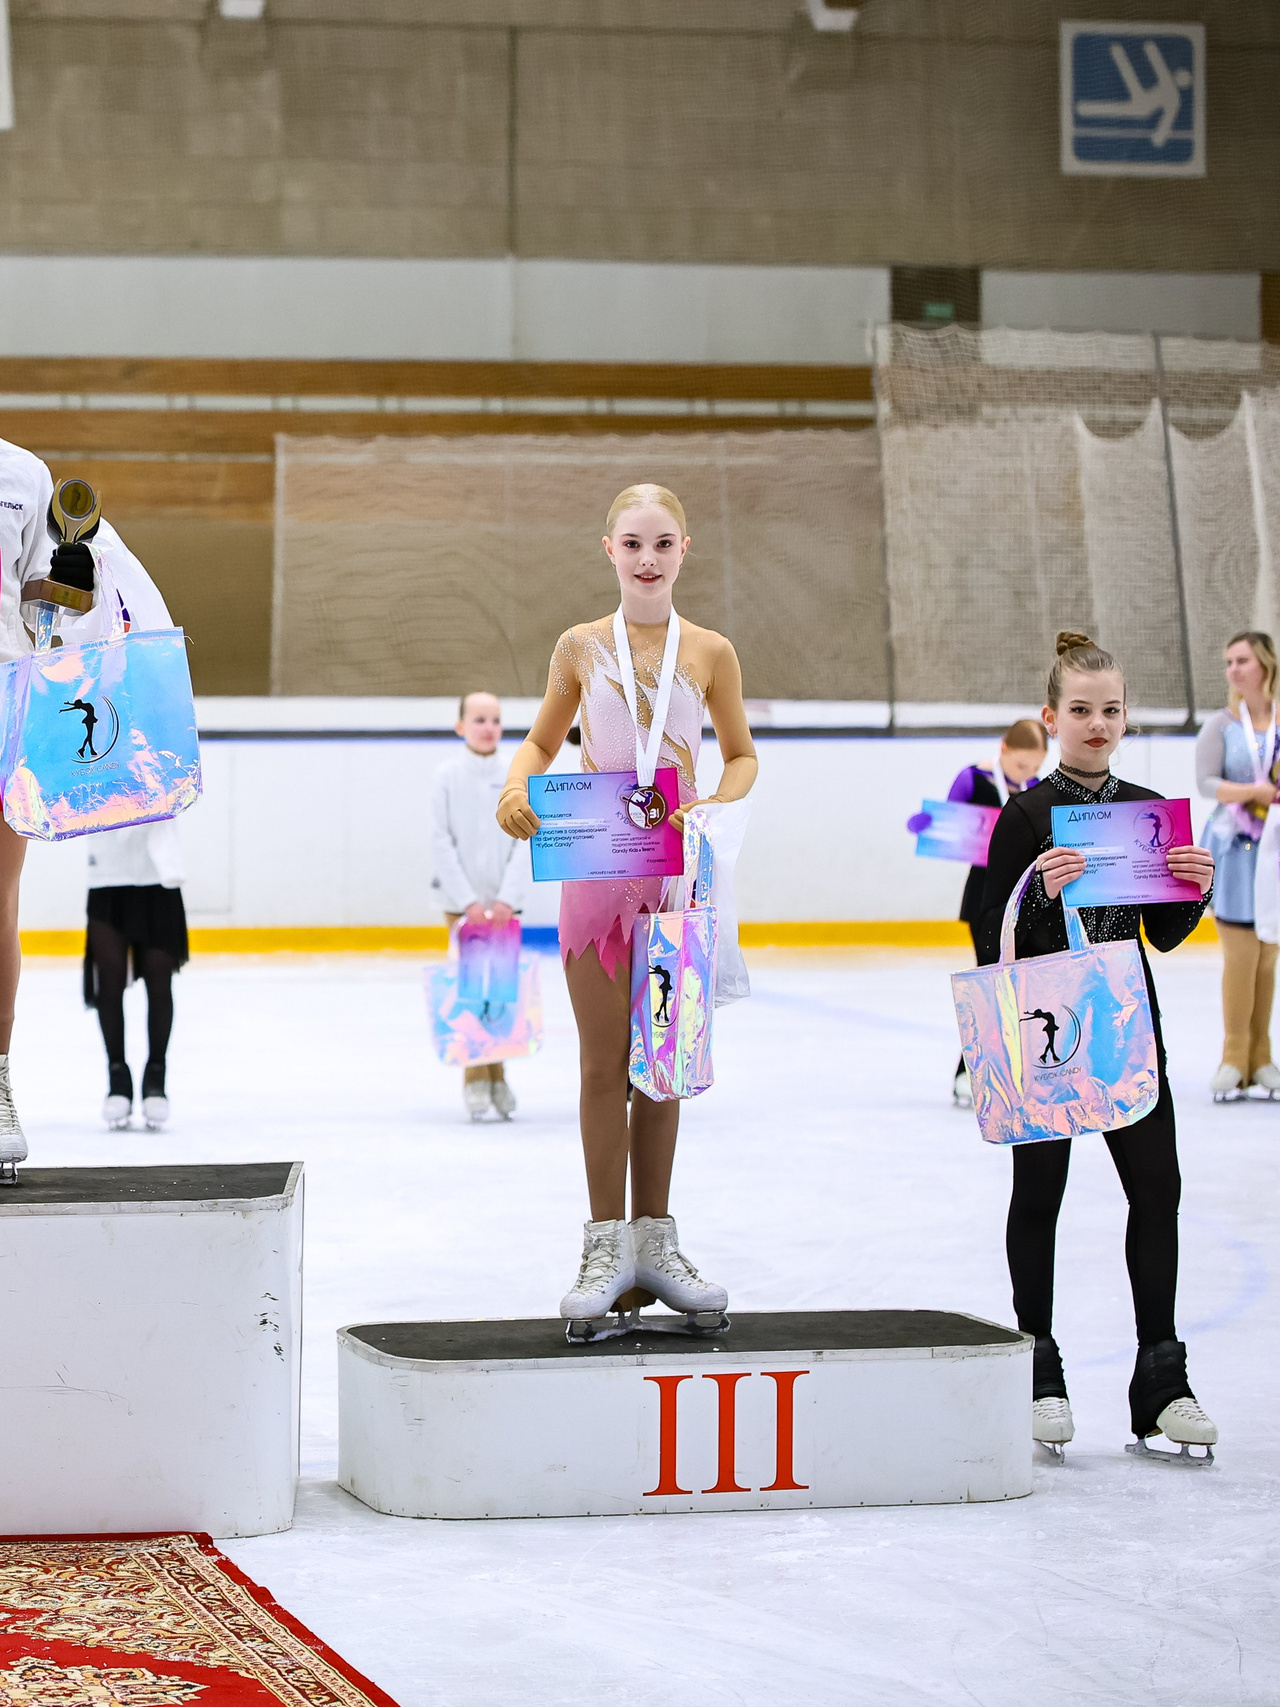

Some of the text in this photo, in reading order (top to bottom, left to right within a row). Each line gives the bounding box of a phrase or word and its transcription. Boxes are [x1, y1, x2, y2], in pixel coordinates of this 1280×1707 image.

[1134, 839, 1157, 855] КУБОК
[1033, 1072, 1058, 1082] КУБОК
[643, 1370, 809, 1495] III
